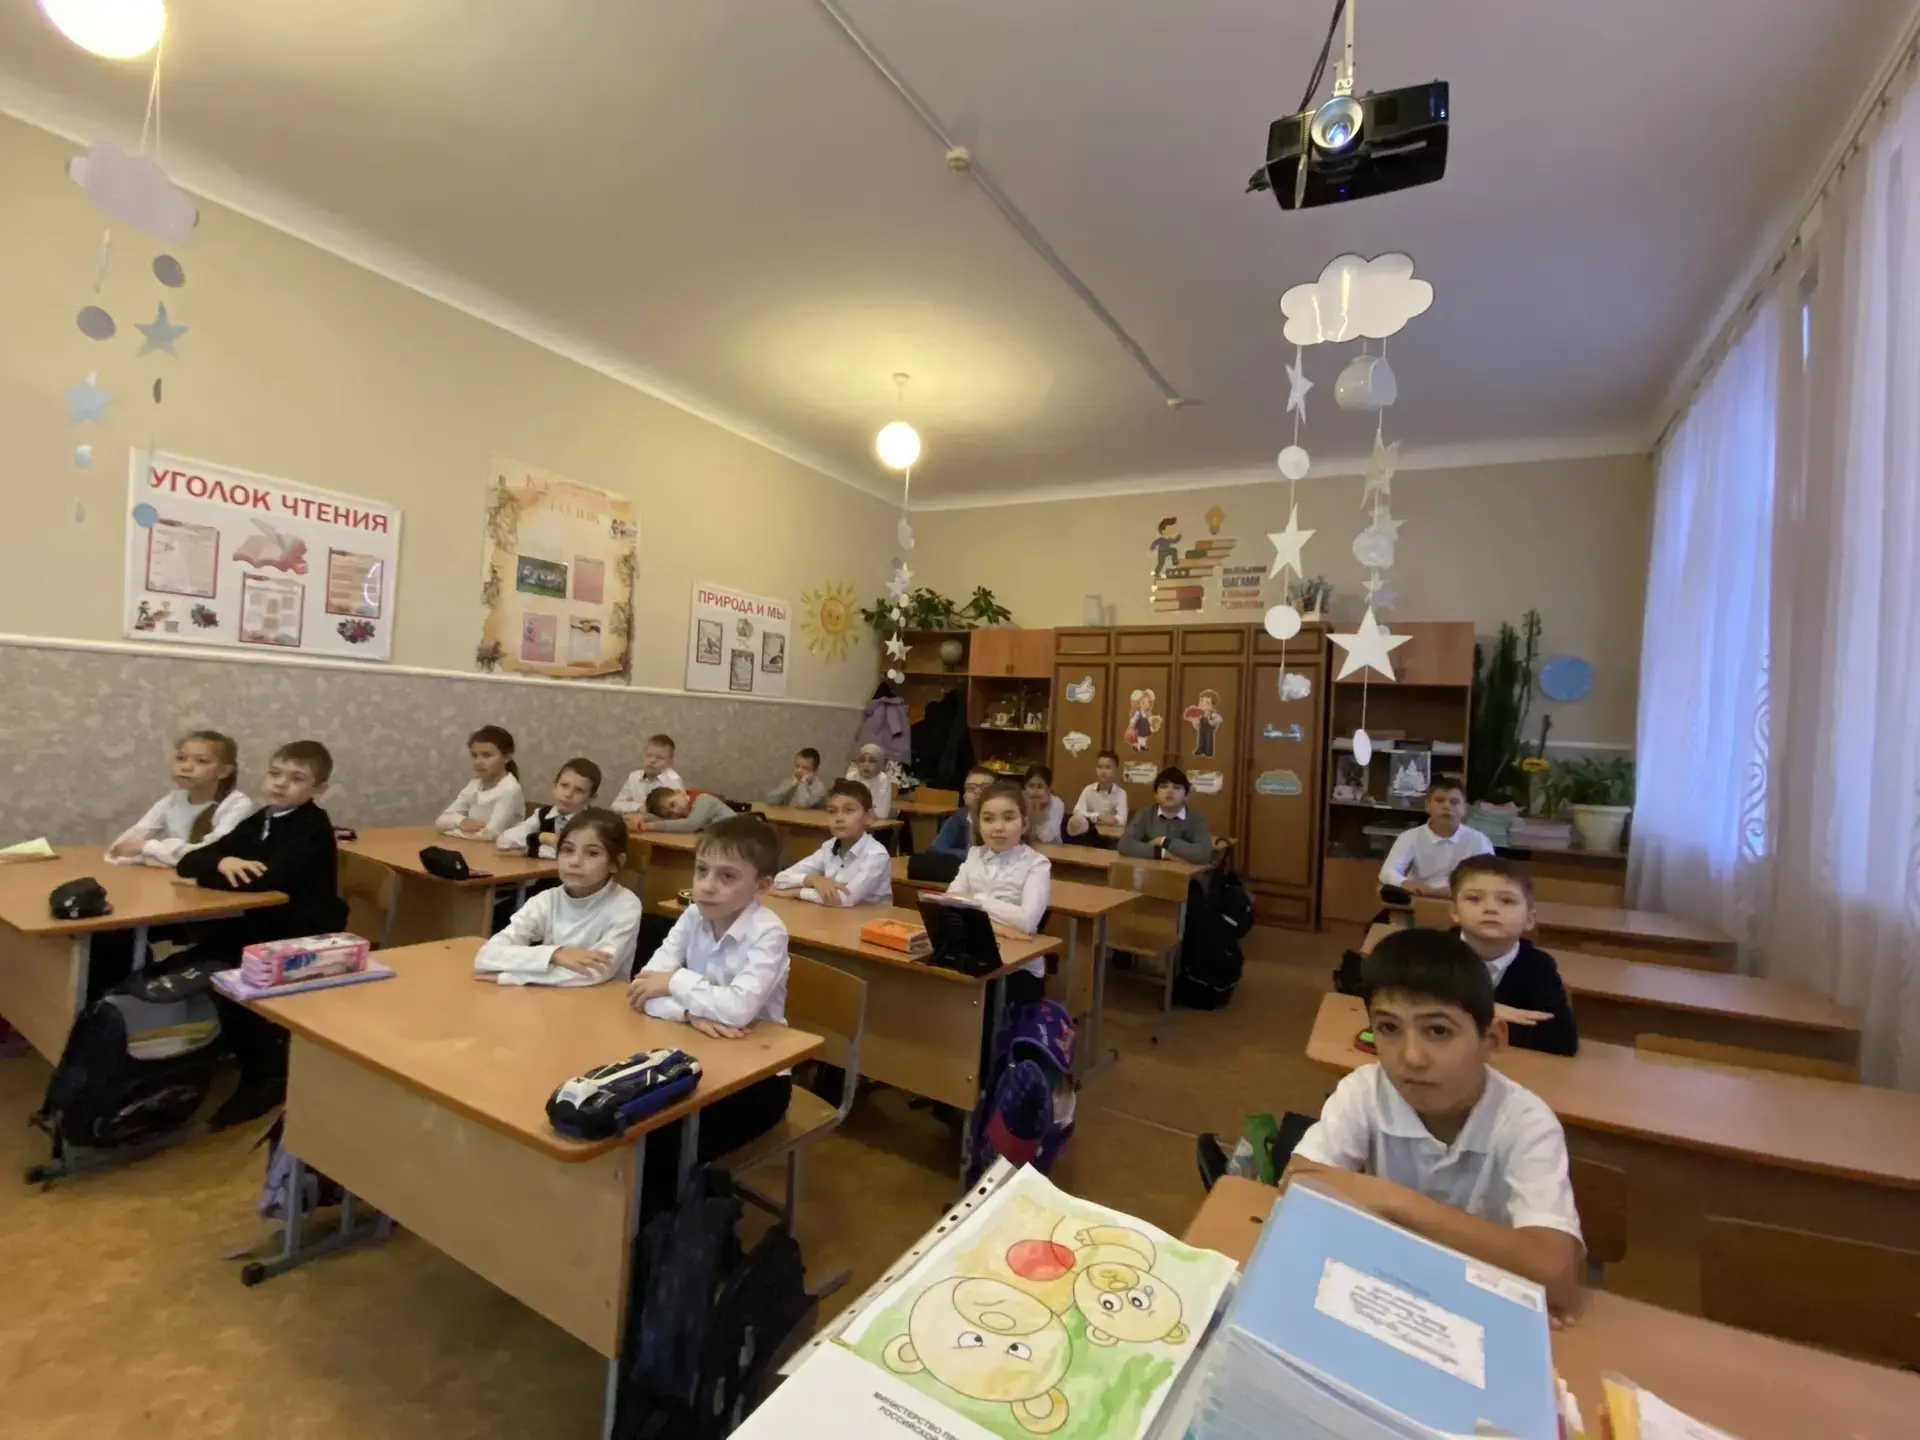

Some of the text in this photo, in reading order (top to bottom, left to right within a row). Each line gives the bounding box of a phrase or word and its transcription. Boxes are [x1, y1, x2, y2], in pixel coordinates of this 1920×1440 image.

[151, 466, 389, 534] УГОЛОК ЧТЕНИЯ
[699, 590, 786, 620] ПРИРОДА И МЫ
[873, 1391, 942, 1434] МИНИСТЕРСТВО
